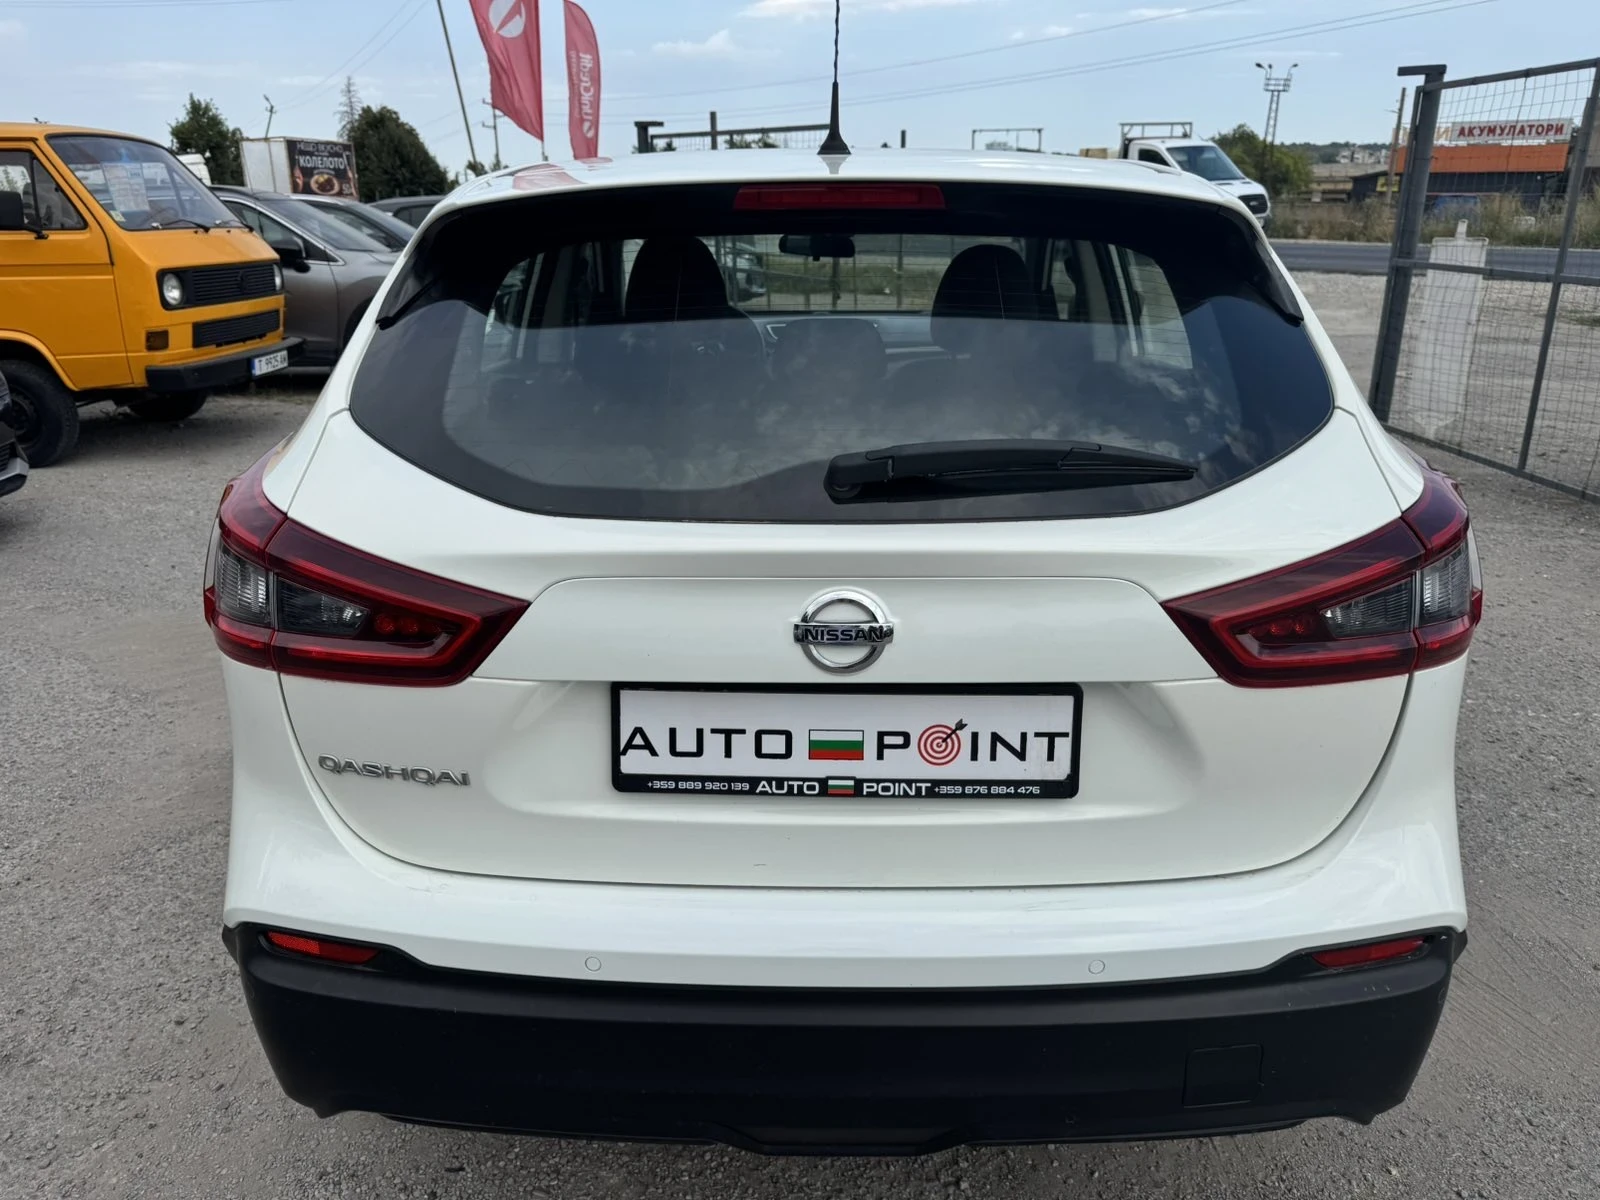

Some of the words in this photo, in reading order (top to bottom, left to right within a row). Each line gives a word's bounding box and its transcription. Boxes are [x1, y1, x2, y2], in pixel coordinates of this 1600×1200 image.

[1458, 123, 1564, 137] АКУМУЛАТОРИ
[804, 627, 883, 642] NISSAN
[620, 726, 793, 760] AUTO
[318, 754, 471, 787] QASHQAI
[647, 781, 676, 789] +359
[678, 781, 702, 790] 889
[704, 782, 728, 791] 920
[730, 782, 750, 791] 139
[756, 780, 820, 794] AUTO
[863, 782, 931, 796] POINT
[933, 785, 962, 794] +359
[964, 785, 988, 794] 876
[990, 786, 1015, 795] 884
[1017, 786, 1040, 795] 476
